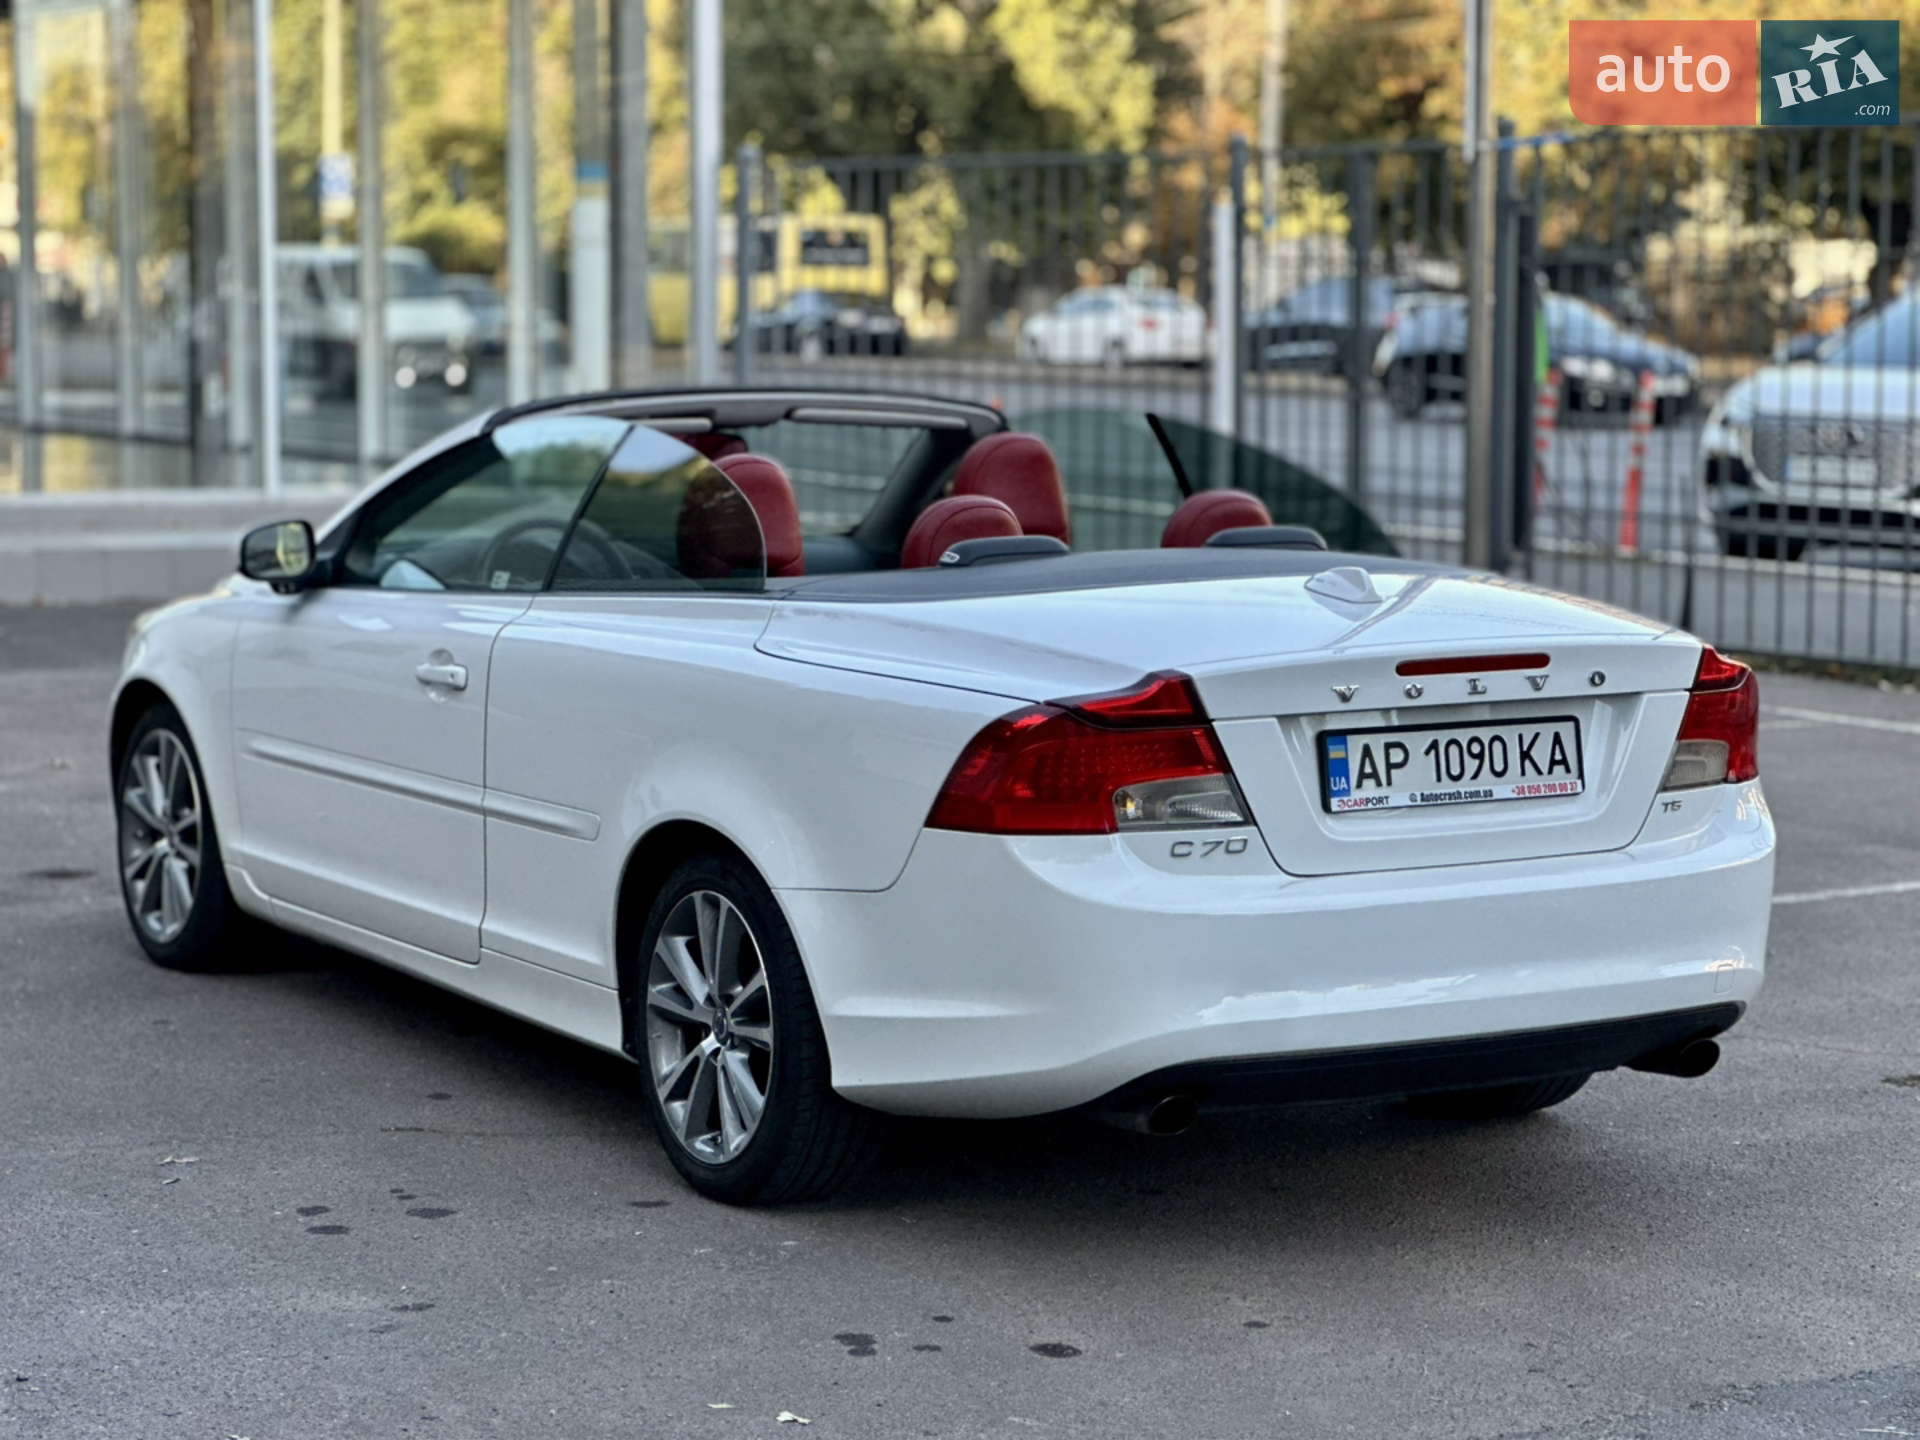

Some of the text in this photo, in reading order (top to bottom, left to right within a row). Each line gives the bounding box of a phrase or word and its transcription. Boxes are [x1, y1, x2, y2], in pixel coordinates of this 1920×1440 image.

[1331, 671, 1606, 703] VOLVO
[1355, 731, 1572, 790] AP 1090 KA
[1330, 776, 1349, 791] UA
[1346, 795, 1390, 809] CARPORT
[1420, 788, 1494, 803] Autocrash.com.ua
